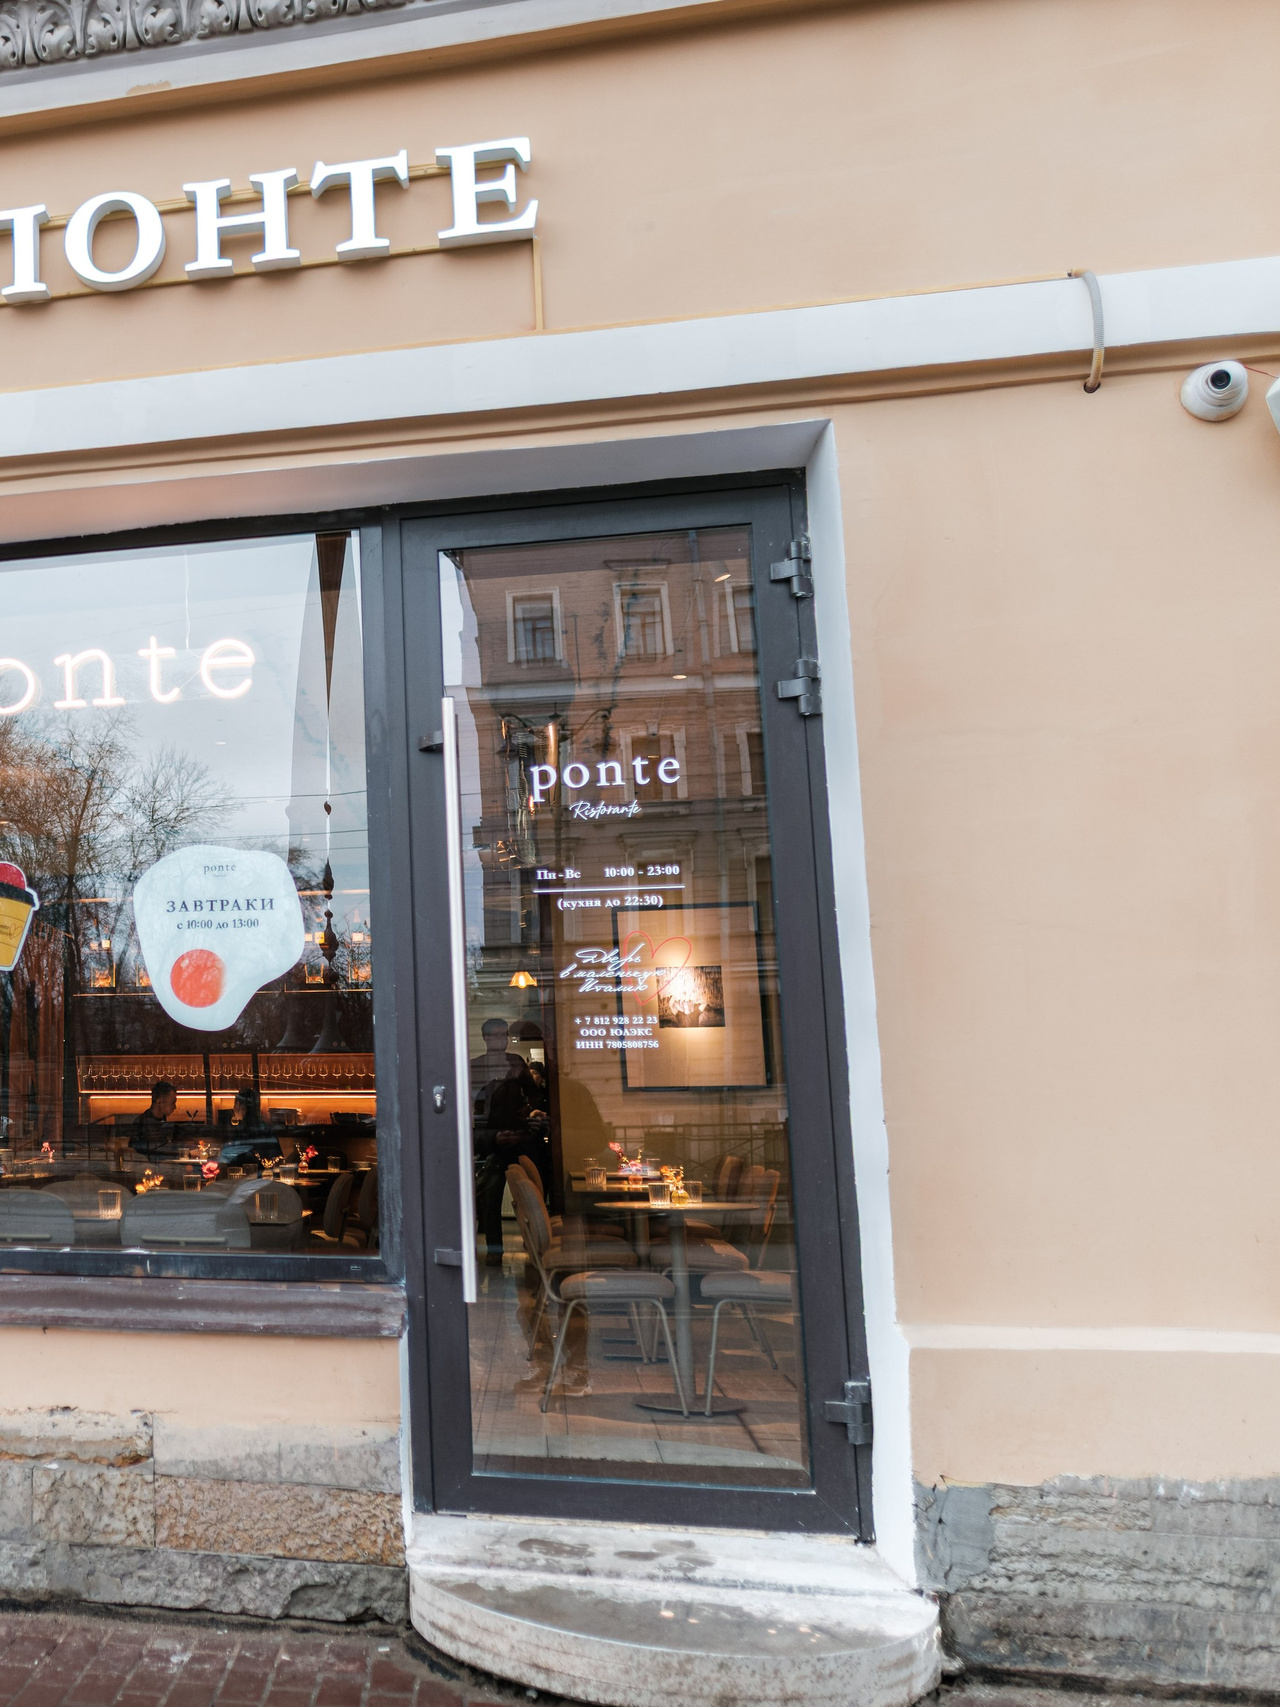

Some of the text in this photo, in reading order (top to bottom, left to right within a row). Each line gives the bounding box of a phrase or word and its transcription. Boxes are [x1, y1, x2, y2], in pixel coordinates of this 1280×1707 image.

[530, 756, 681, 802] ponte
[569, 799, 642, 820] Ristorante
[604, 867, 635, 878] 10:00
[647, 865, 680, 876] 23:00
[166, 898, 275, 913] ЗАВТРАКИ
[557, 895, 663, 911] (кухня до 22:30)
[176, 918, 260, 930] с 10:00 до 13:00
[575, 942, 646, 972] Дверь
[578, 978, 649, 993] Италию
[593, 1016, 610, 1025] 812
[612, 1016, 630, 1025] 928
[632, 1016, 644, 1024] 22
[646, 1015, 658, 1024] 23
[580, 1028, 653, 1037] ООО ЮЛЭКС
[576, 1040, 659, 1049] ИНН 7805808756
